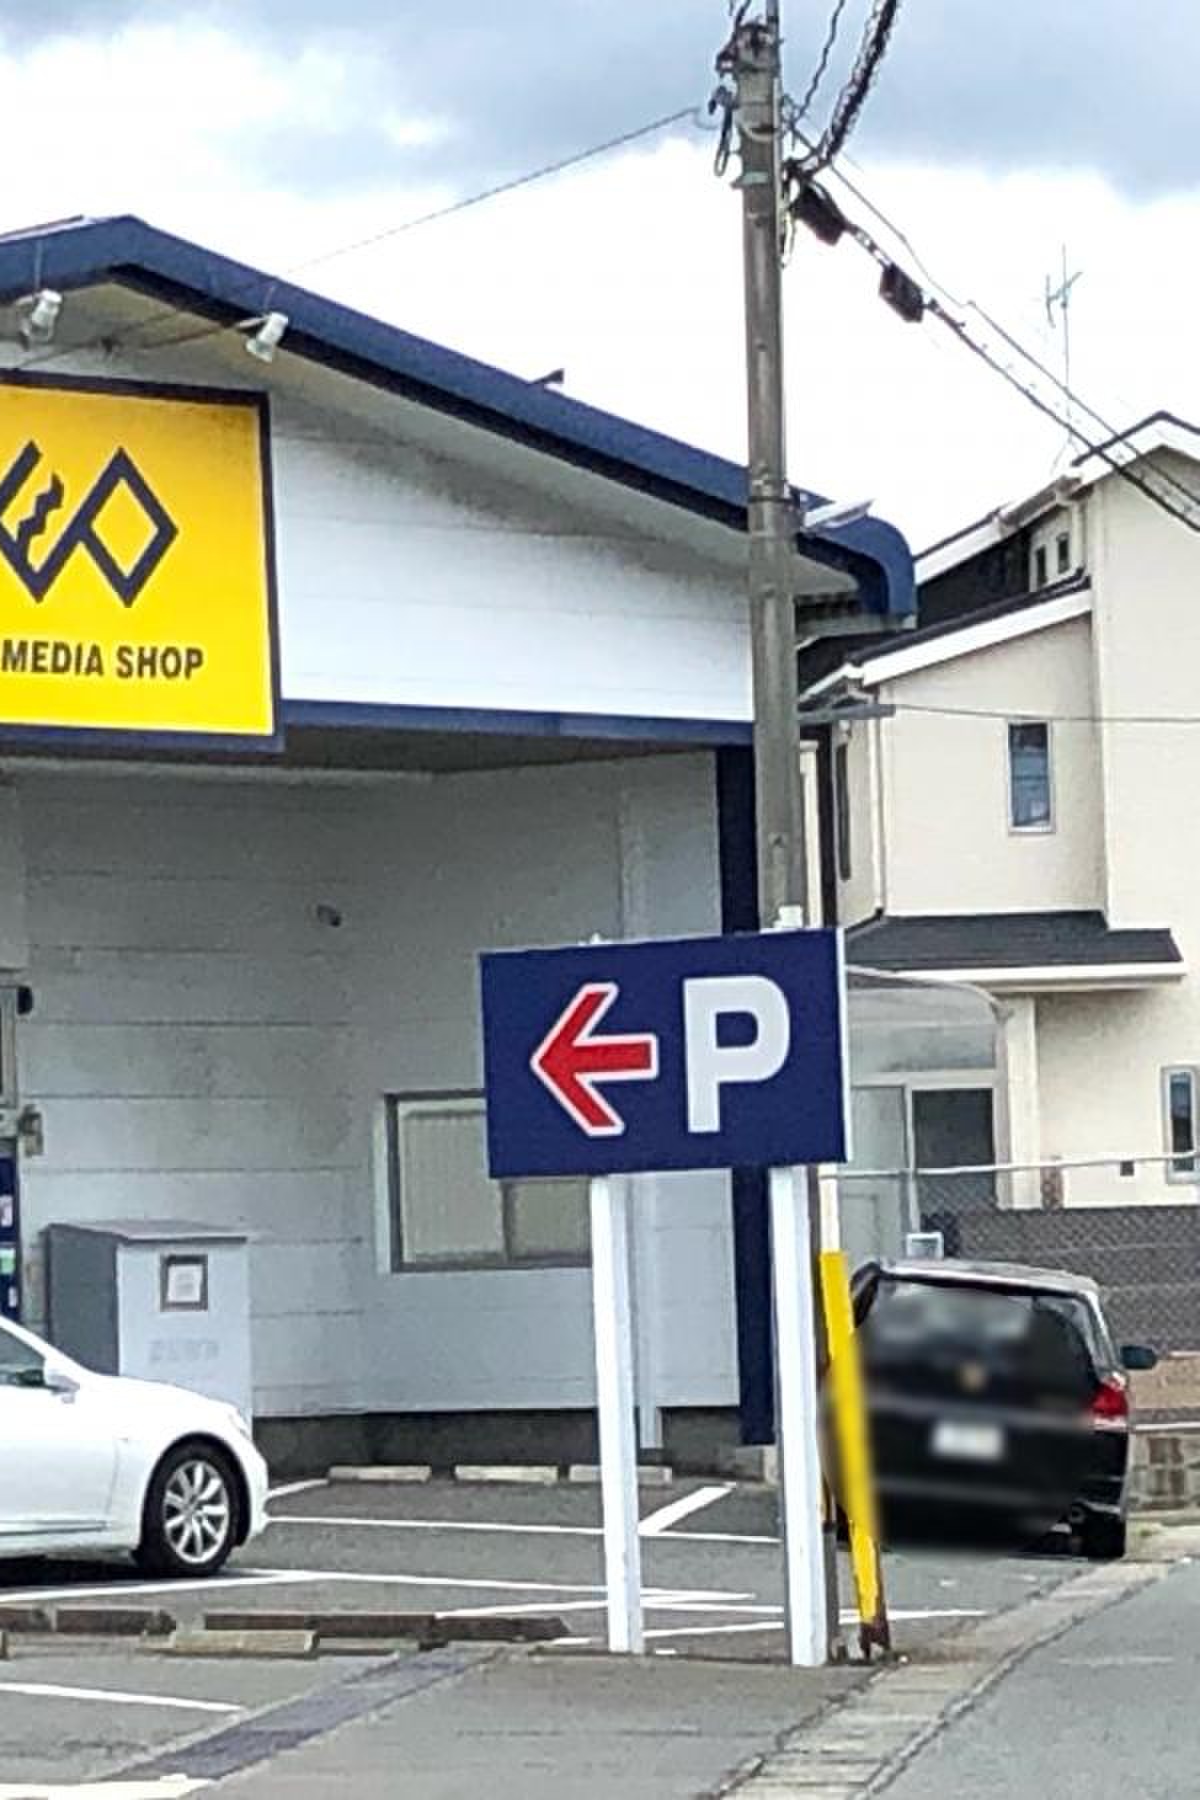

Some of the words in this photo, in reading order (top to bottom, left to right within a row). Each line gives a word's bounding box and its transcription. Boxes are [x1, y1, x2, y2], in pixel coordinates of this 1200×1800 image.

[1, 639, 103, 676] MEDIA
[115, 645, 204, 680] SHOP
[682, 975, 791, 1133] P
